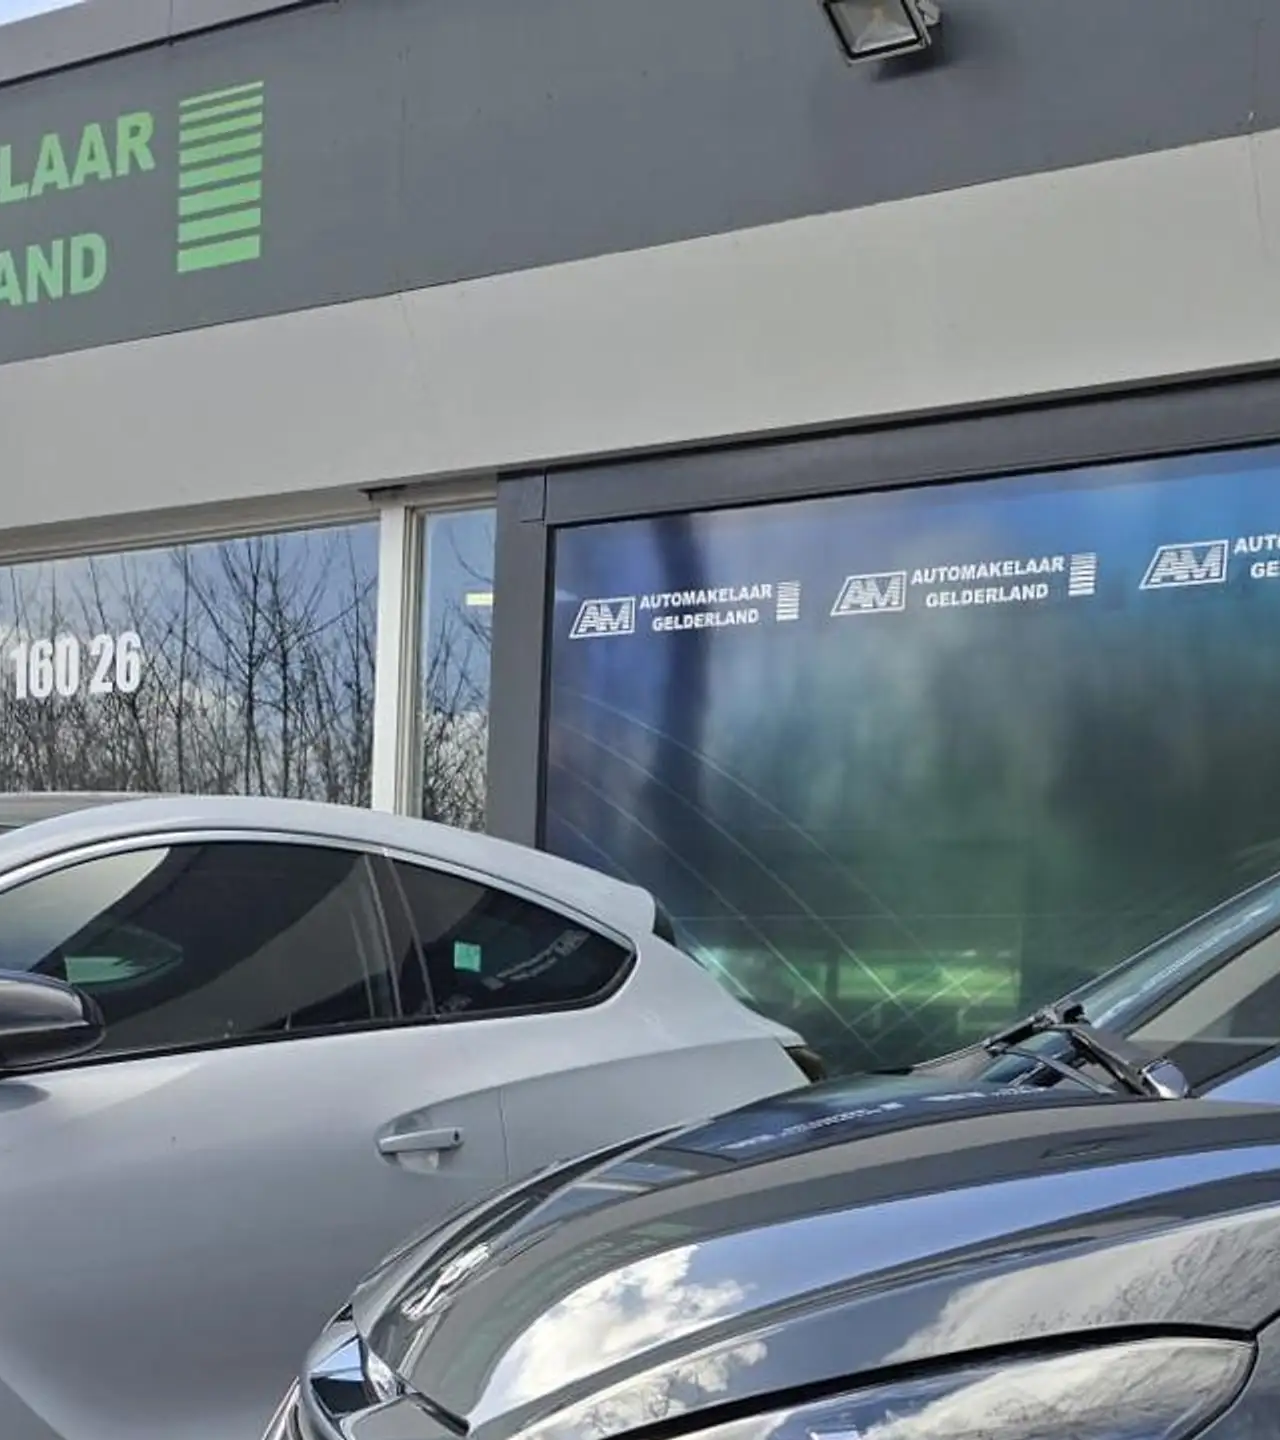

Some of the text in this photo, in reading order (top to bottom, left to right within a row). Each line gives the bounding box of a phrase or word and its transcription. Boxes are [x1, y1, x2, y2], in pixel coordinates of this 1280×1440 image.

[911, 556, 1064, 585] AUTOMAKELAAR
[1148, 544, 1223, 585] AM
[640, 583, 773, 609] AUTOMAKELAAR
[838, 576, 903, 611] AM
[926, 583, 1049, 608] GELDERLAND
[576, 601, 632, 635] AM
[652, 609, 759, 632] GELDERLAND
[9, 635, 81, 700] 160
[90, 630, 142, 694] 26
